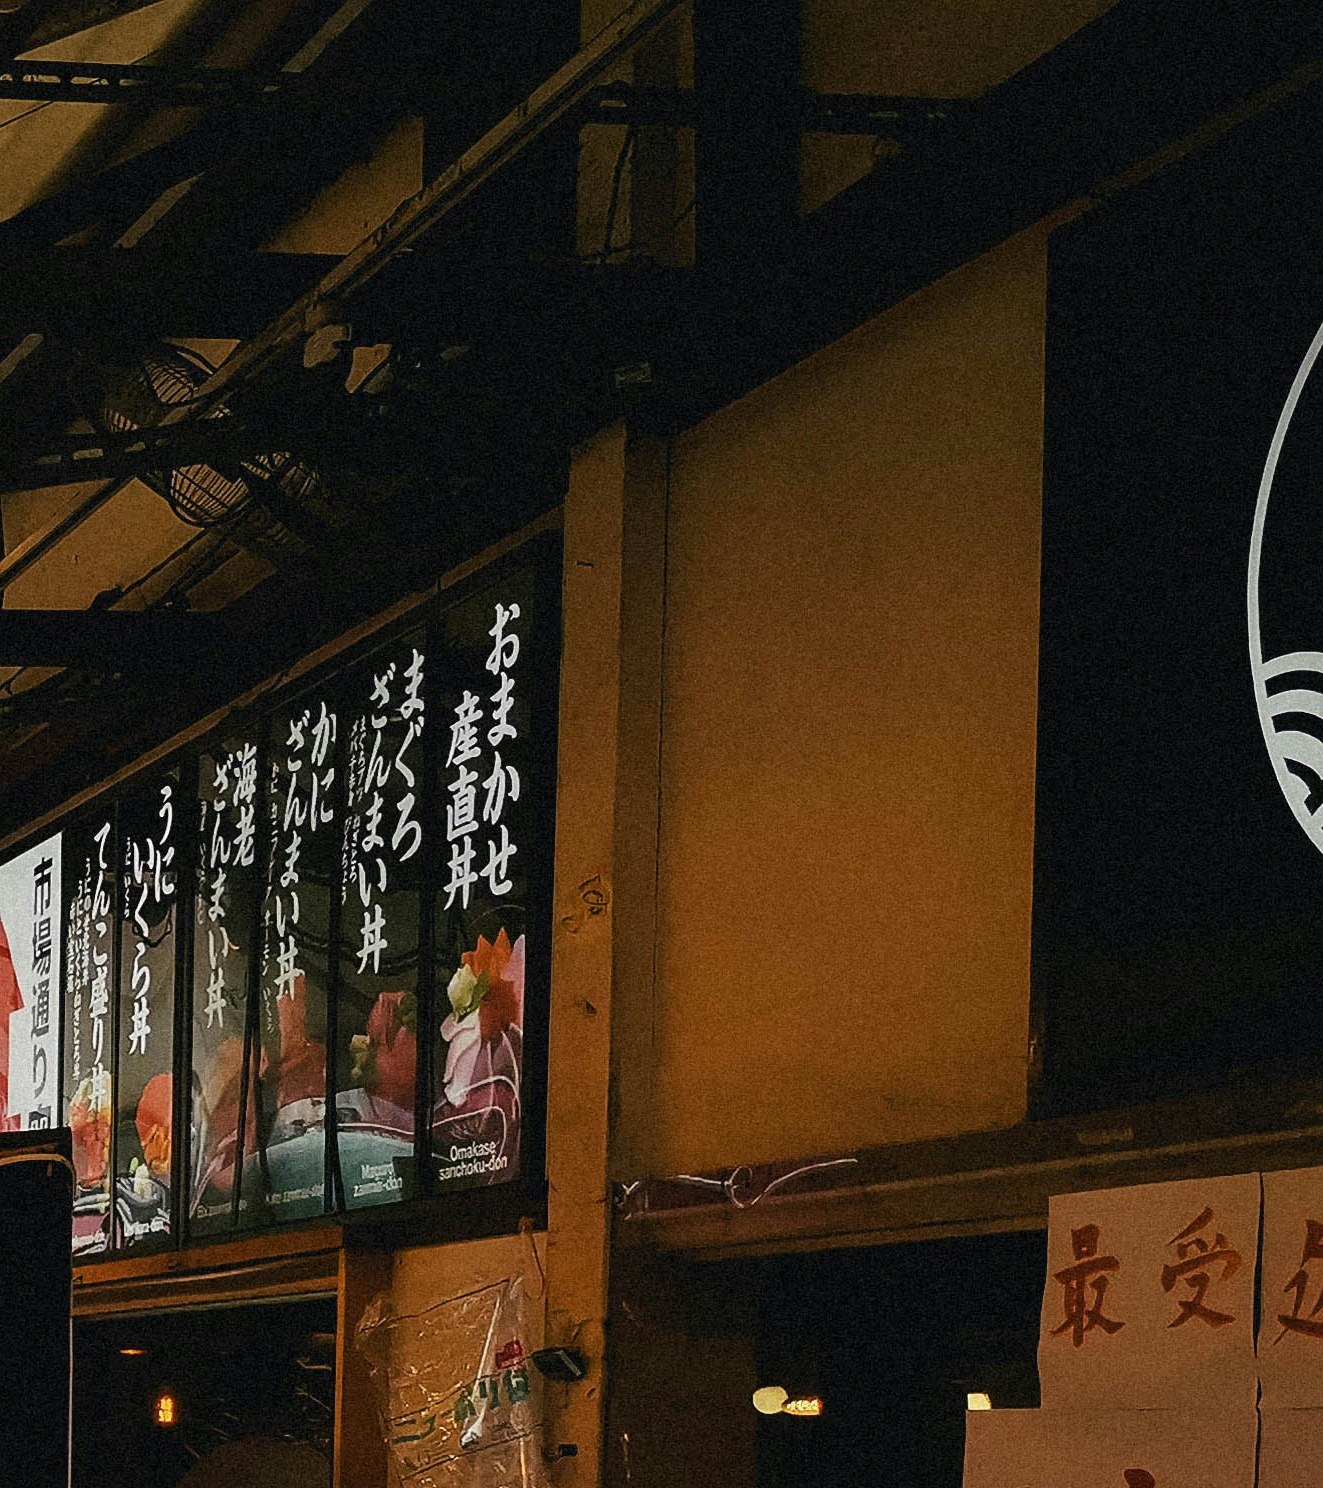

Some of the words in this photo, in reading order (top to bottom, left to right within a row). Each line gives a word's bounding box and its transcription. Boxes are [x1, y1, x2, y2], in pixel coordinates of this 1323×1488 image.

[156, 785, 176, 902] うに
[233, 742, 257, 867] 海老
[273, 710, 311, 1001] ざんまい丼
[311, 702, 337, 832] かに
[356, 662, 397, 974] ざんまい丼
[392, 648, 425, 862] まぐろ
[444, 690, 483, 910] 産直丼
[480, 603, 521, 896] おまかせ
[129, 837, 153, 1056] いくら丼
[205, 754, 233, 1029] ざんまい丼
